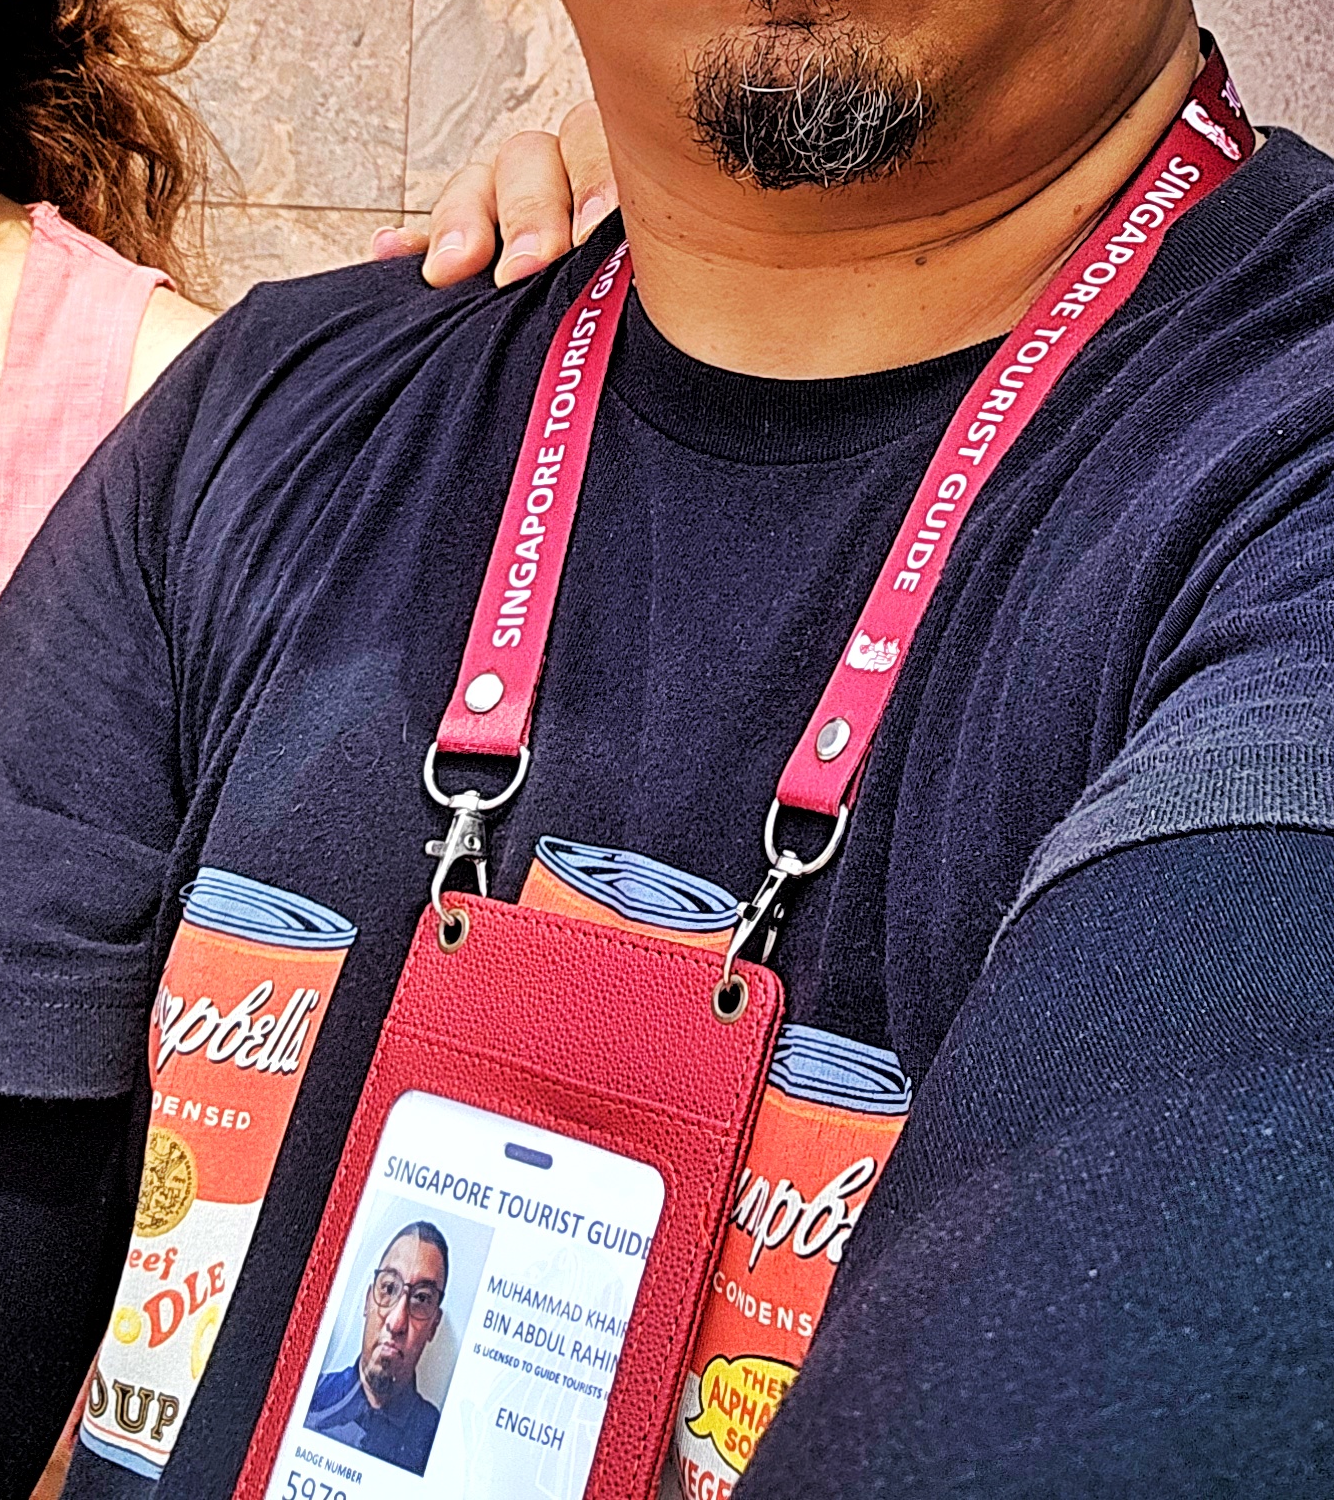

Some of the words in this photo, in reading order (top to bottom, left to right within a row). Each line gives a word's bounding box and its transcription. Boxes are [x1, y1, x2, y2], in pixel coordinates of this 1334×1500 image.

[1051, 156, 1200, 321] SINGAPORE
[958, 324, 1067, 466] TOURIST
[492, 443, 566, 648] SINGAPORE
[544, 307, 602, 438] TOURIST
[893, 472, 969, 593] GUIDE
[383, 1155, 494, 1211] SINGAPORE
[497, 1189, 585, 1239] TOURIST
[142, 1260, 226, 1349] DLE
[482, 1308, 512, 1336] BIN
[511, 1320, 566, 1357] ABDUL
[486, 1274, 583, 1323] MUHAMMAD
[473, 1342, 482, 1355] IS
[482, 1346, 520, 1369] LICENSED
[522, 1359, 533, 1374] TO
[534, 1365, 561, 1385] GUIDE
[562, 1375, 603, 1400] TOURISTS
[741, 1365, 779, 1400] THE
[495, 1407, 566, 1452] ENGLISH
[294, 1446, 325, 1468] BADGE
[324, 1458, 363, 1485] NUMBER
